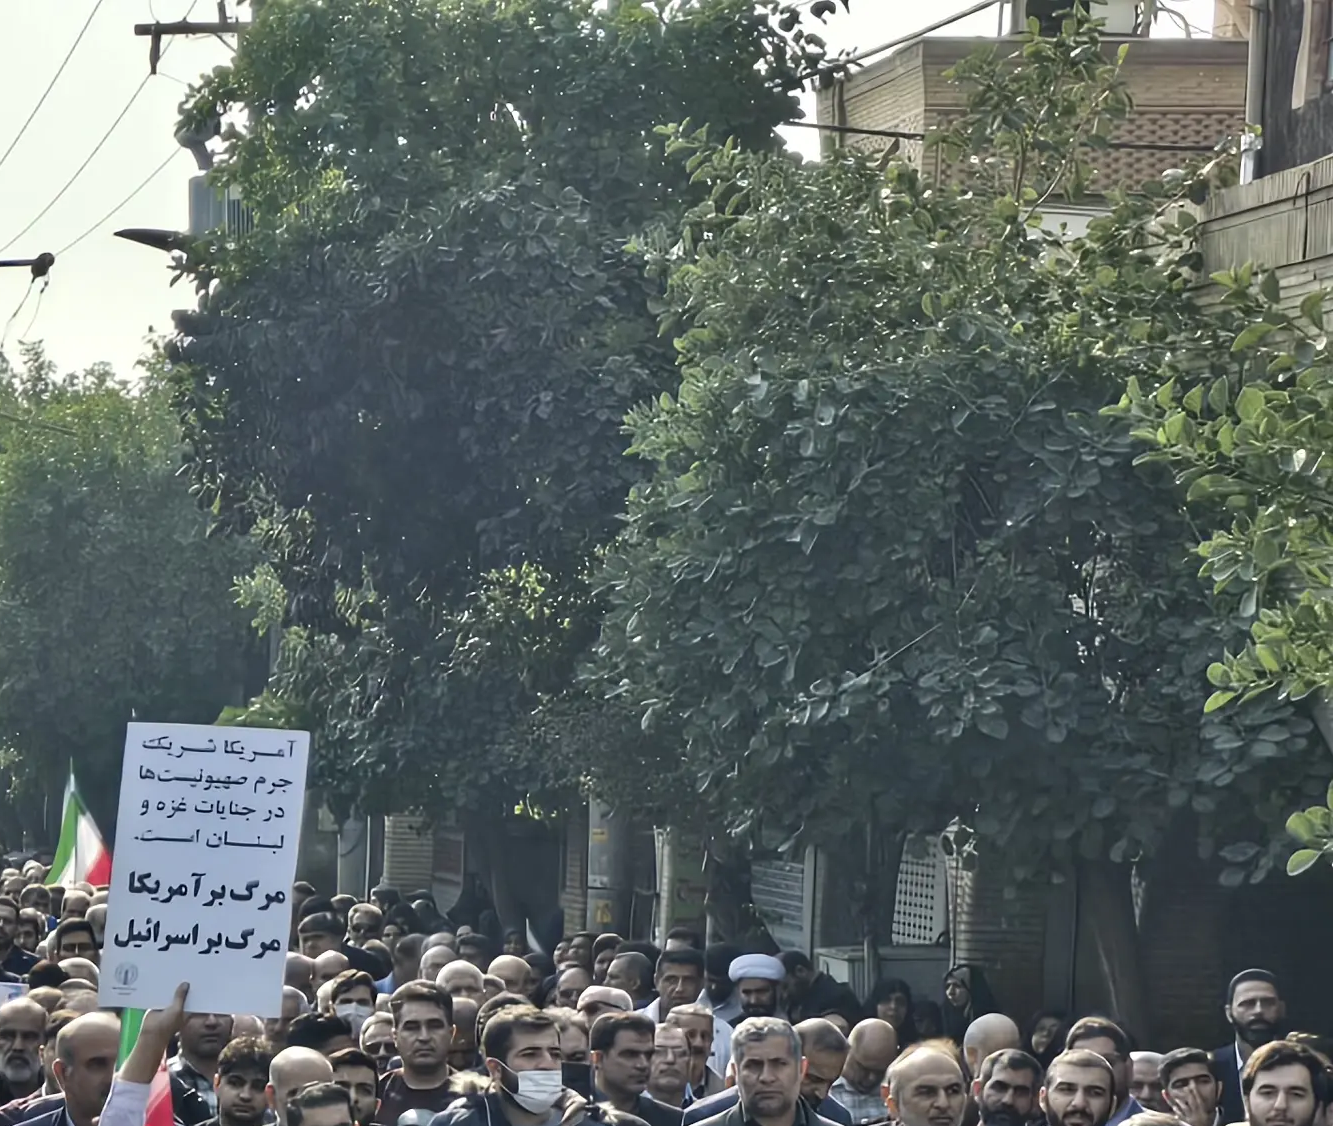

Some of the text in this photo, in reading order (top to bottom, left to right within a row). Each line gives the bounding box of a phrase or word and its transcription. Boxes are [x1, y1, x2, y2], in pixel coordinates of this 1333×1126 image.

[224, 740, 297, 762] آمریکا
[253, 776, 293, 794] جرم
[140, 797, 285, 822] در جنایات غزه و
[206, 831, 284, 854] لبنان
[128, 871, 286, 910] مرگ بر آمریکا
[114, 918, 281, 958] مرگ بر اسرائیل
